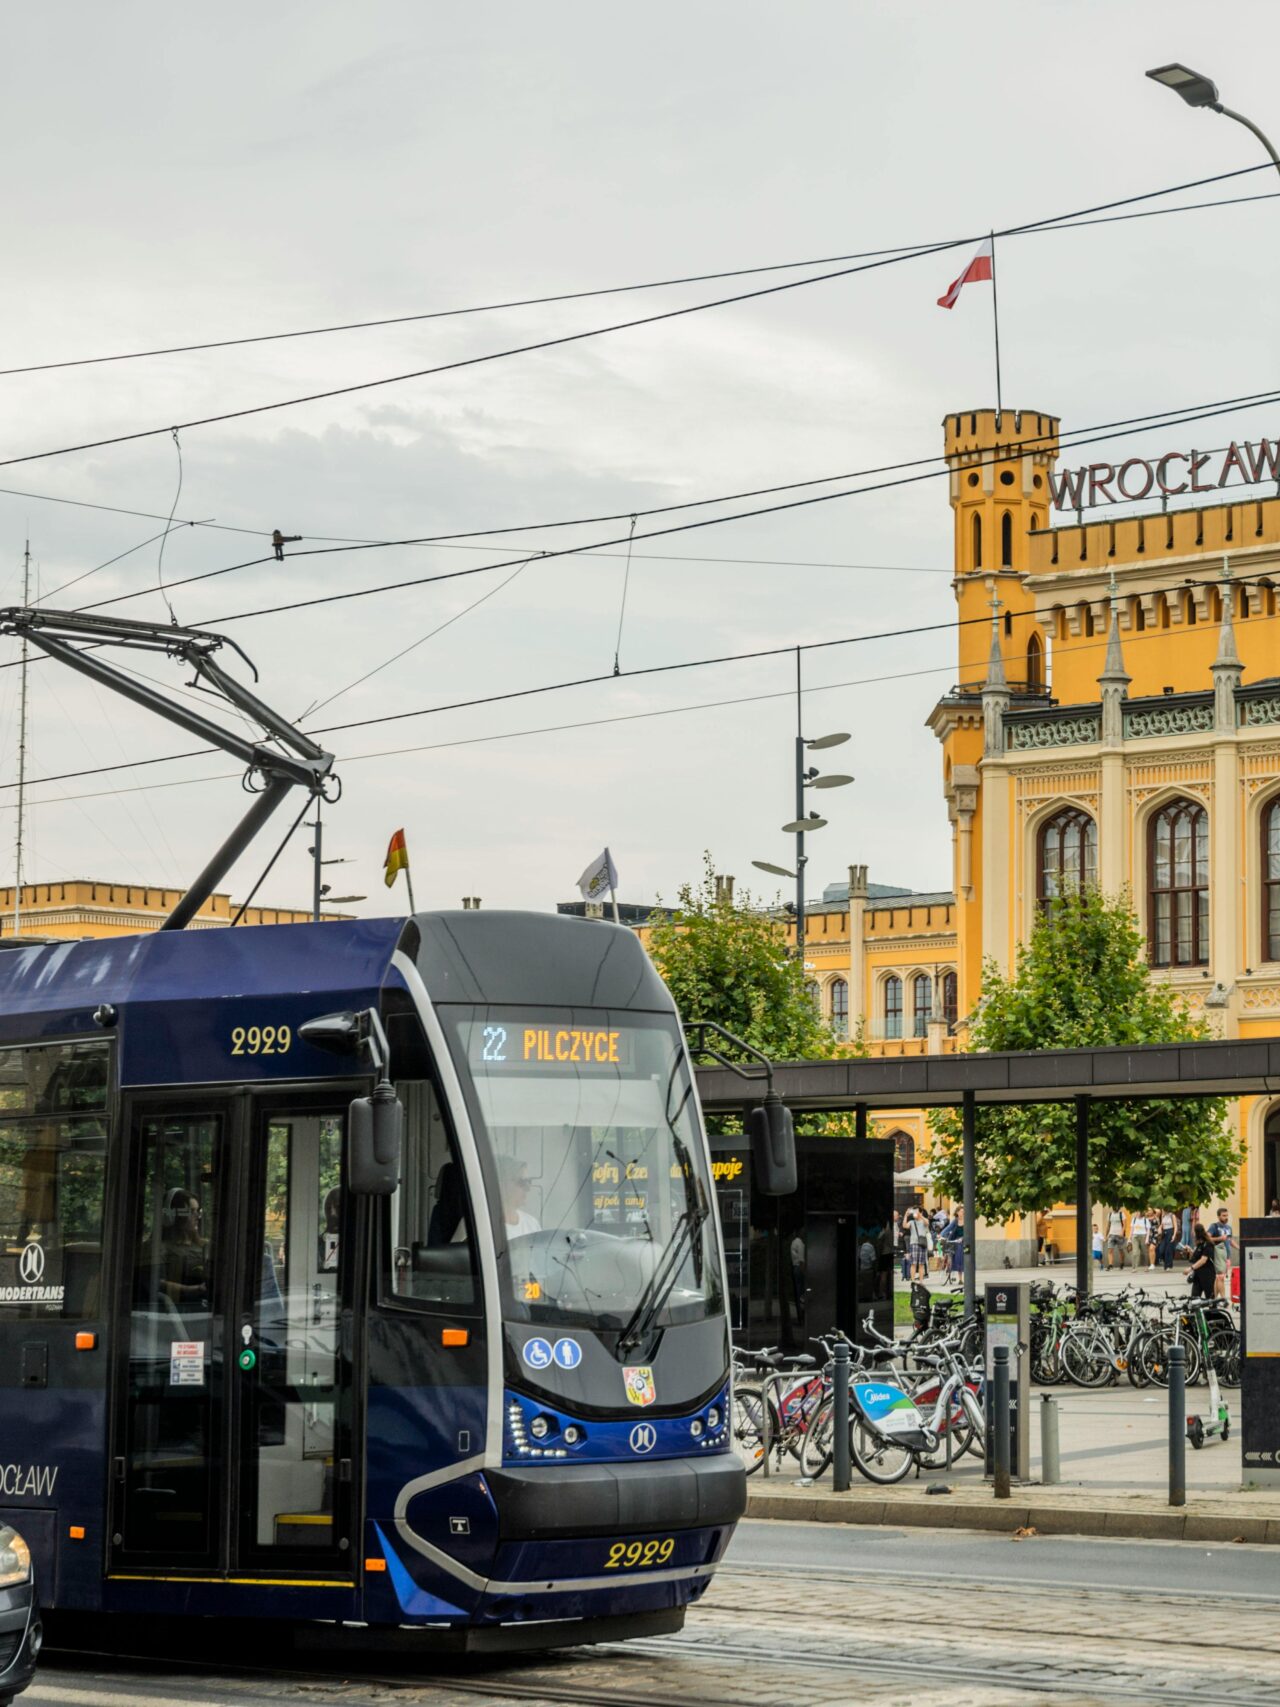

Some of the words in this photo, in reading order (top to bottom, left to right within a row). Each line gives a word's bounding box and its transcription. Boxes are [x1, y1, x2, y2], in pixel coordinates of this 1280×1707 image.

[230, 1025, 291, 1055] 2929
[483, 1026, 507, 1061] 22
[523, 1029, 621, 1062] PILCZYCE
[0, 1286, 65, 1300] MODERTRANS
[524, 1282, 541, 1299] 20
[604, 1538, 675, 1569] 2929
